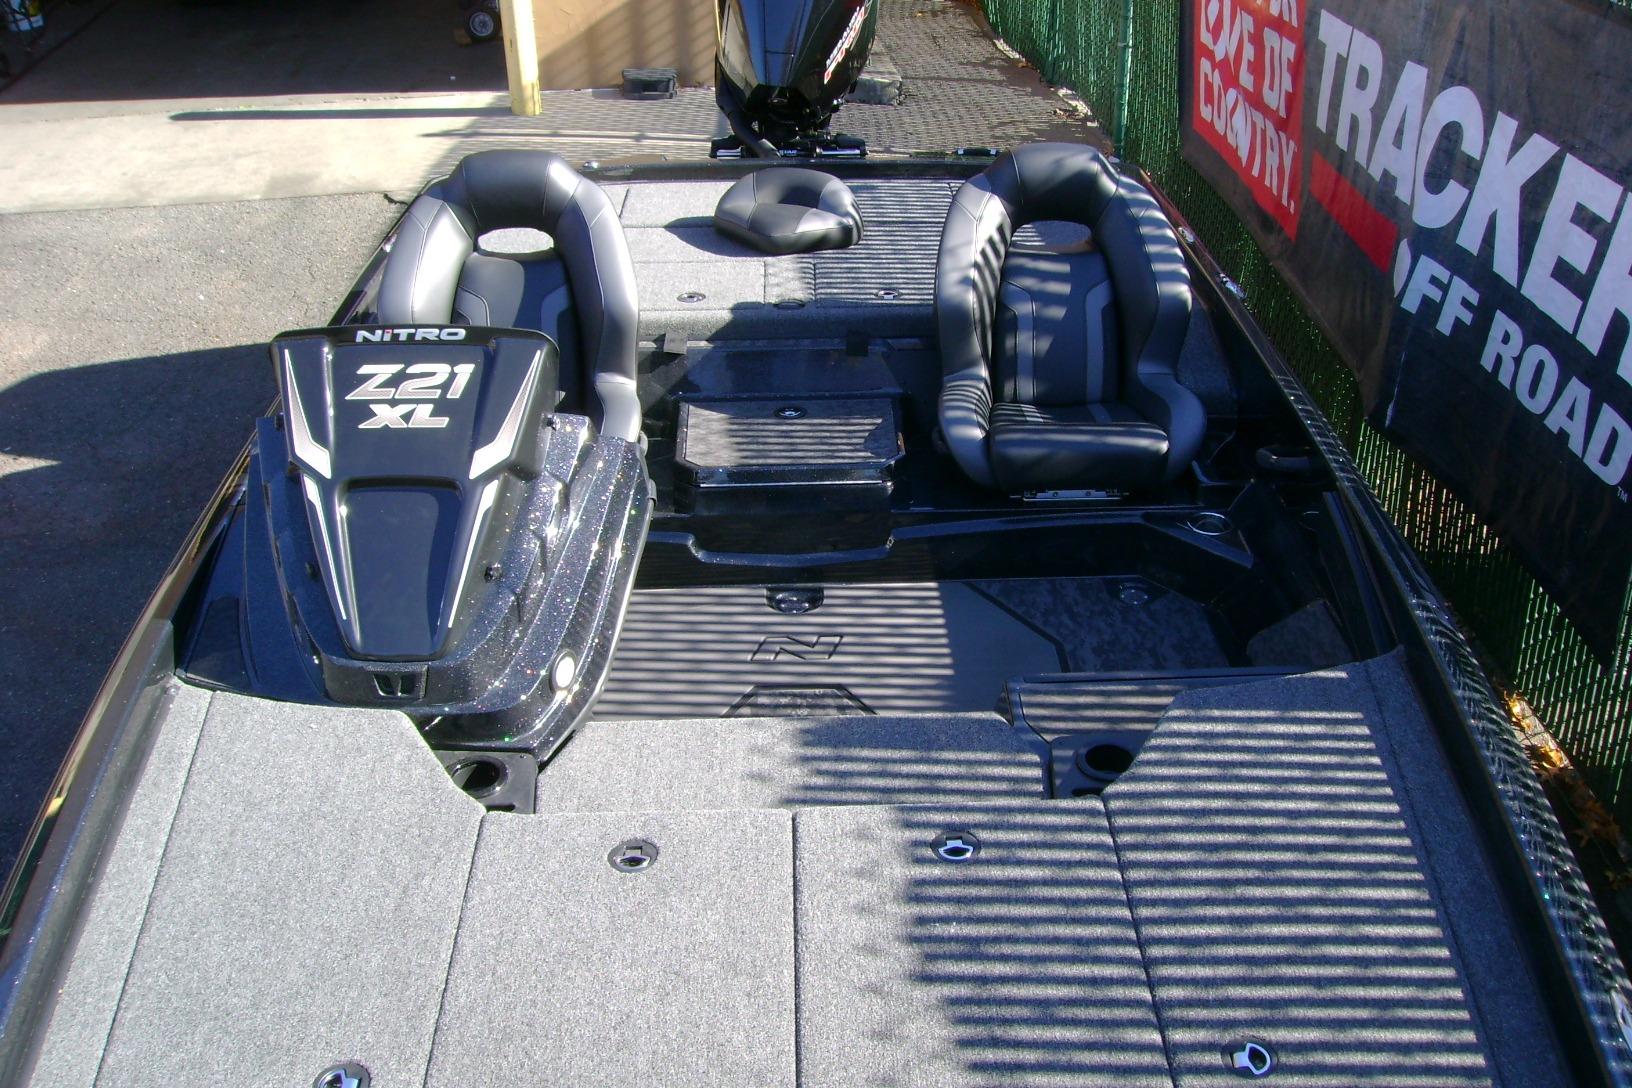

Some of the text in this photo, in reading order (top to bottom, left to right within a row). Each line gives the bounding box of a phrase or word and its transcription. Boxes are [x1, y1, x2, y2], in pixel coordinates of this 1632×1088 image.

[1263, 27, 1296, 119] OF
[344, 363, 476, 400] Z21
[1480, 309, 1632, 486] ROAD
[358, 403, 450, 428] XL
